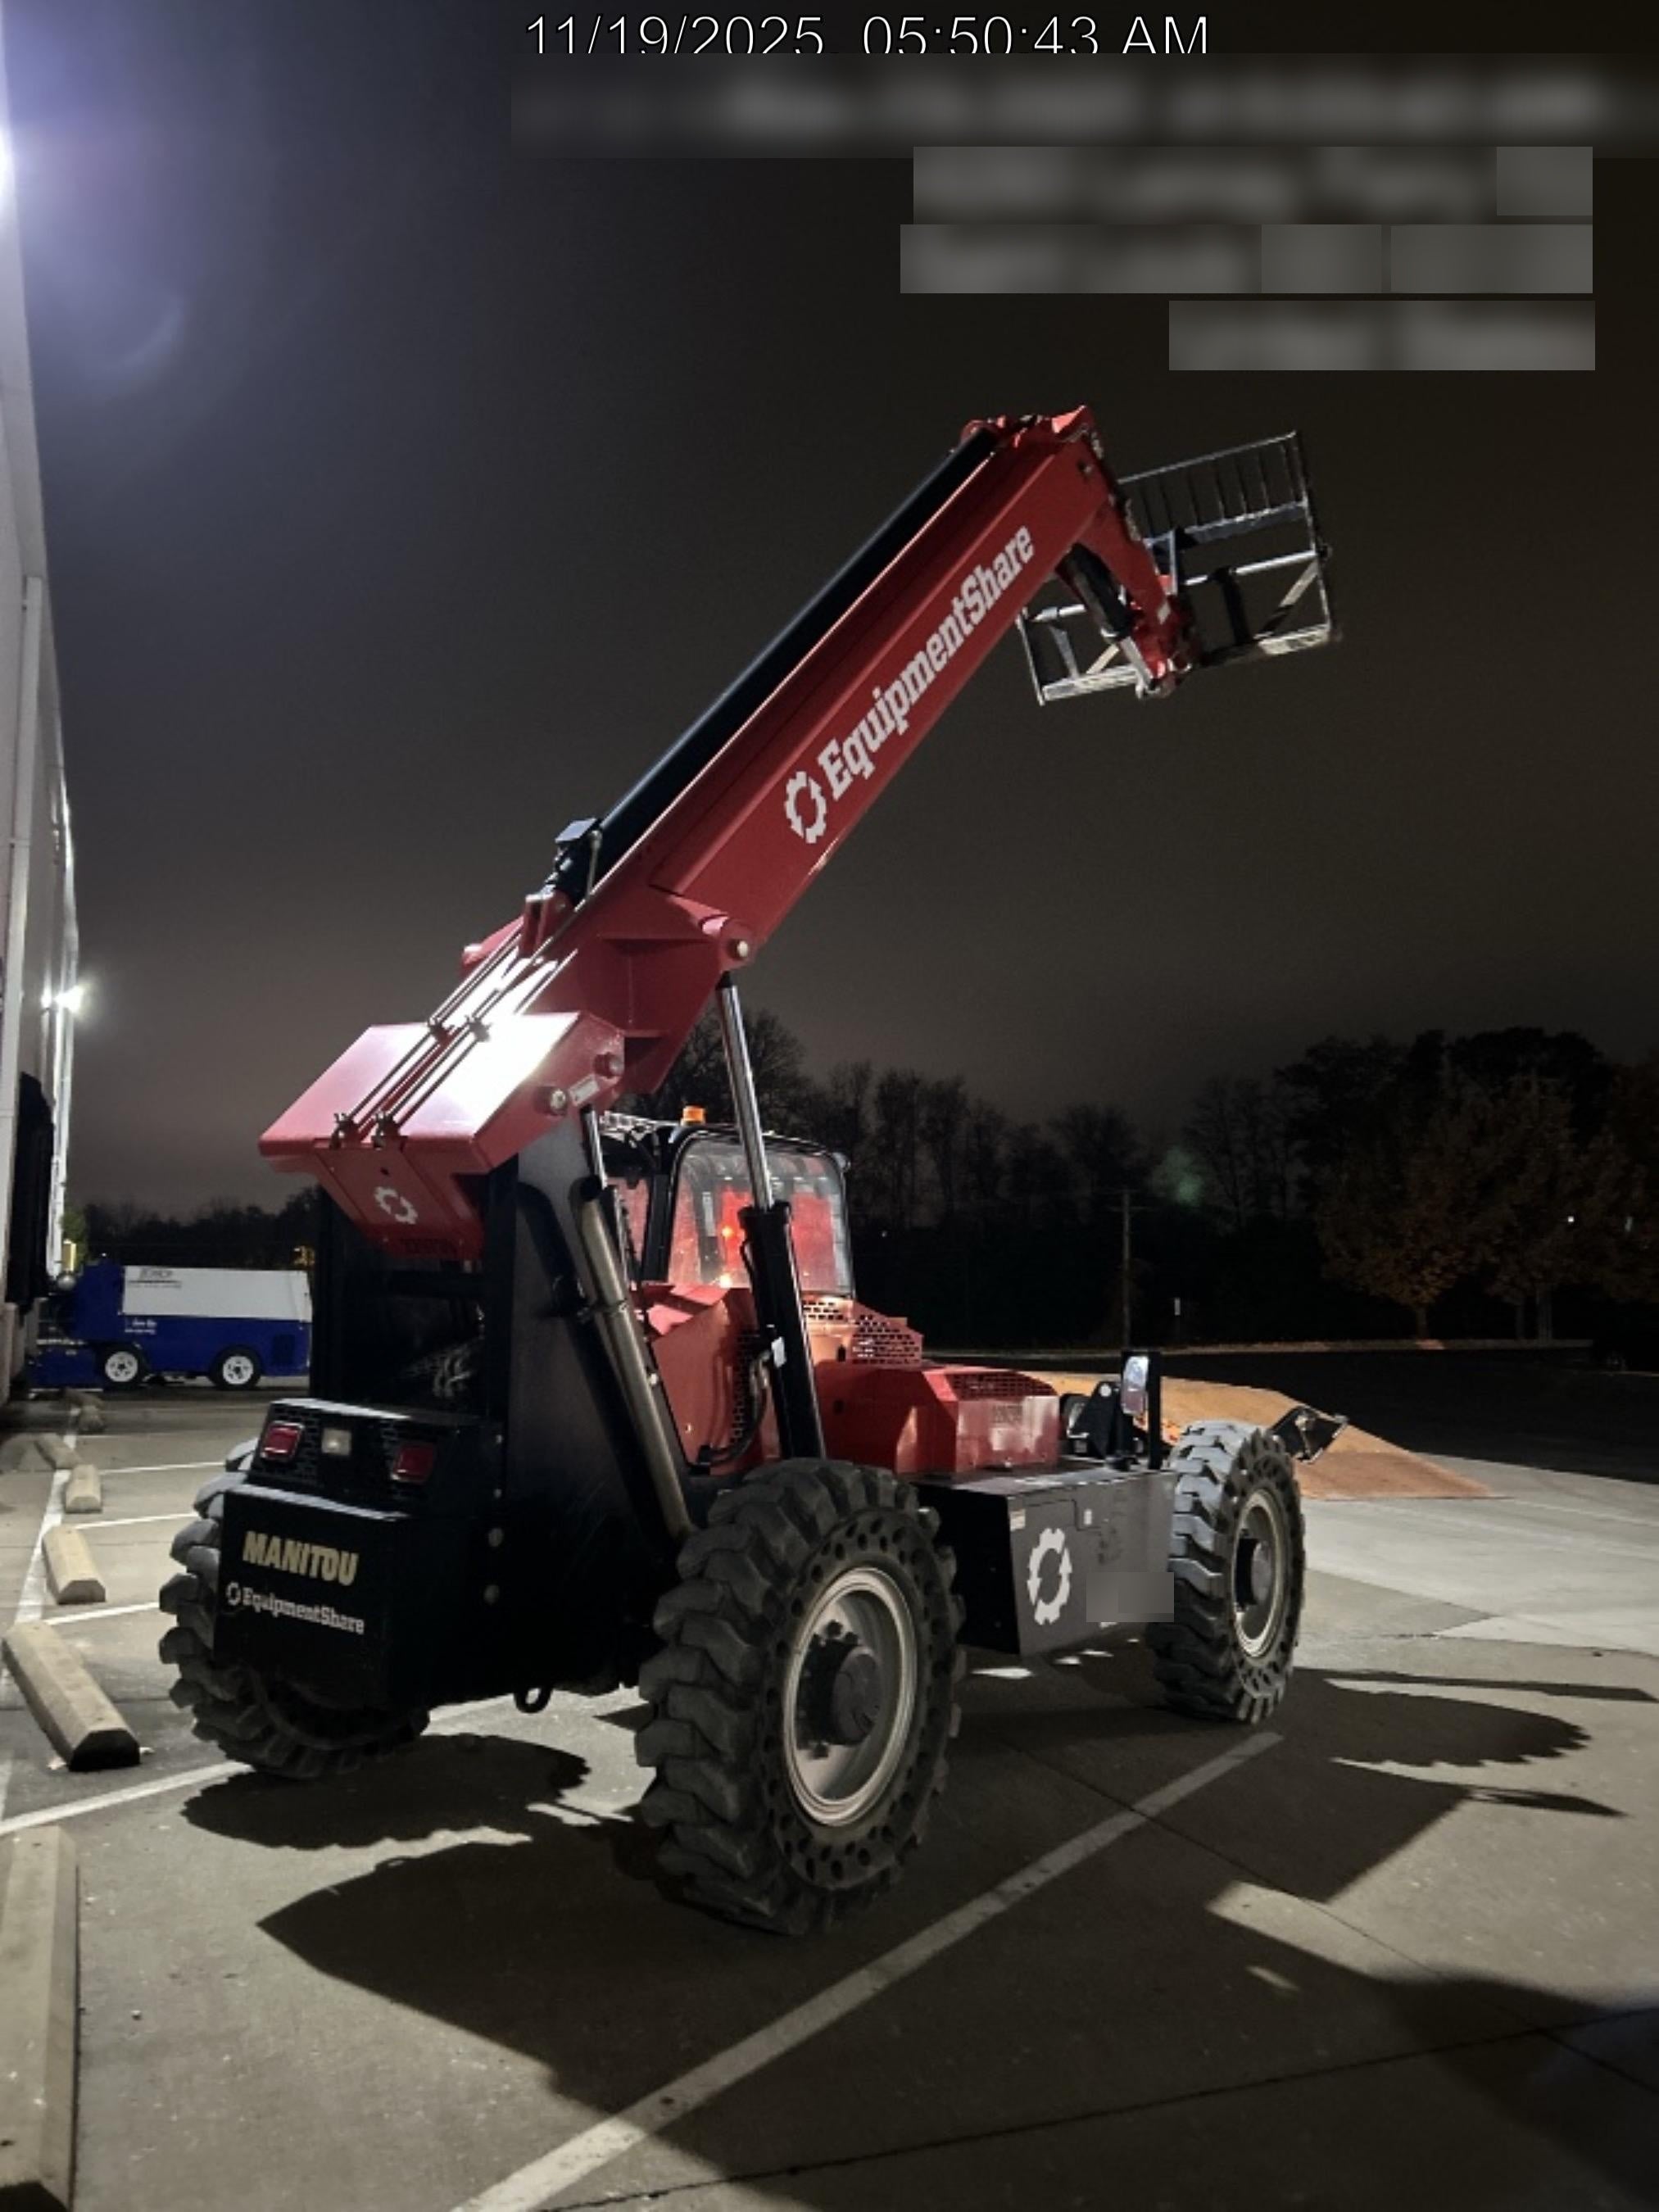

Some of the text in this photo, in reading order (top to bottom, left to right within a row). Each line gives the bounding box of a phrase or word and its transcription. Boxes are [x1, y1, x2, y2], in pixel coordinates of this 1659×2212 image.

[817, 525, 1034, 801] EquipmentShare
[243, 1530, 359, 1586] MANITOU
[243, 1586, 365, 1635] EquipmentShare
